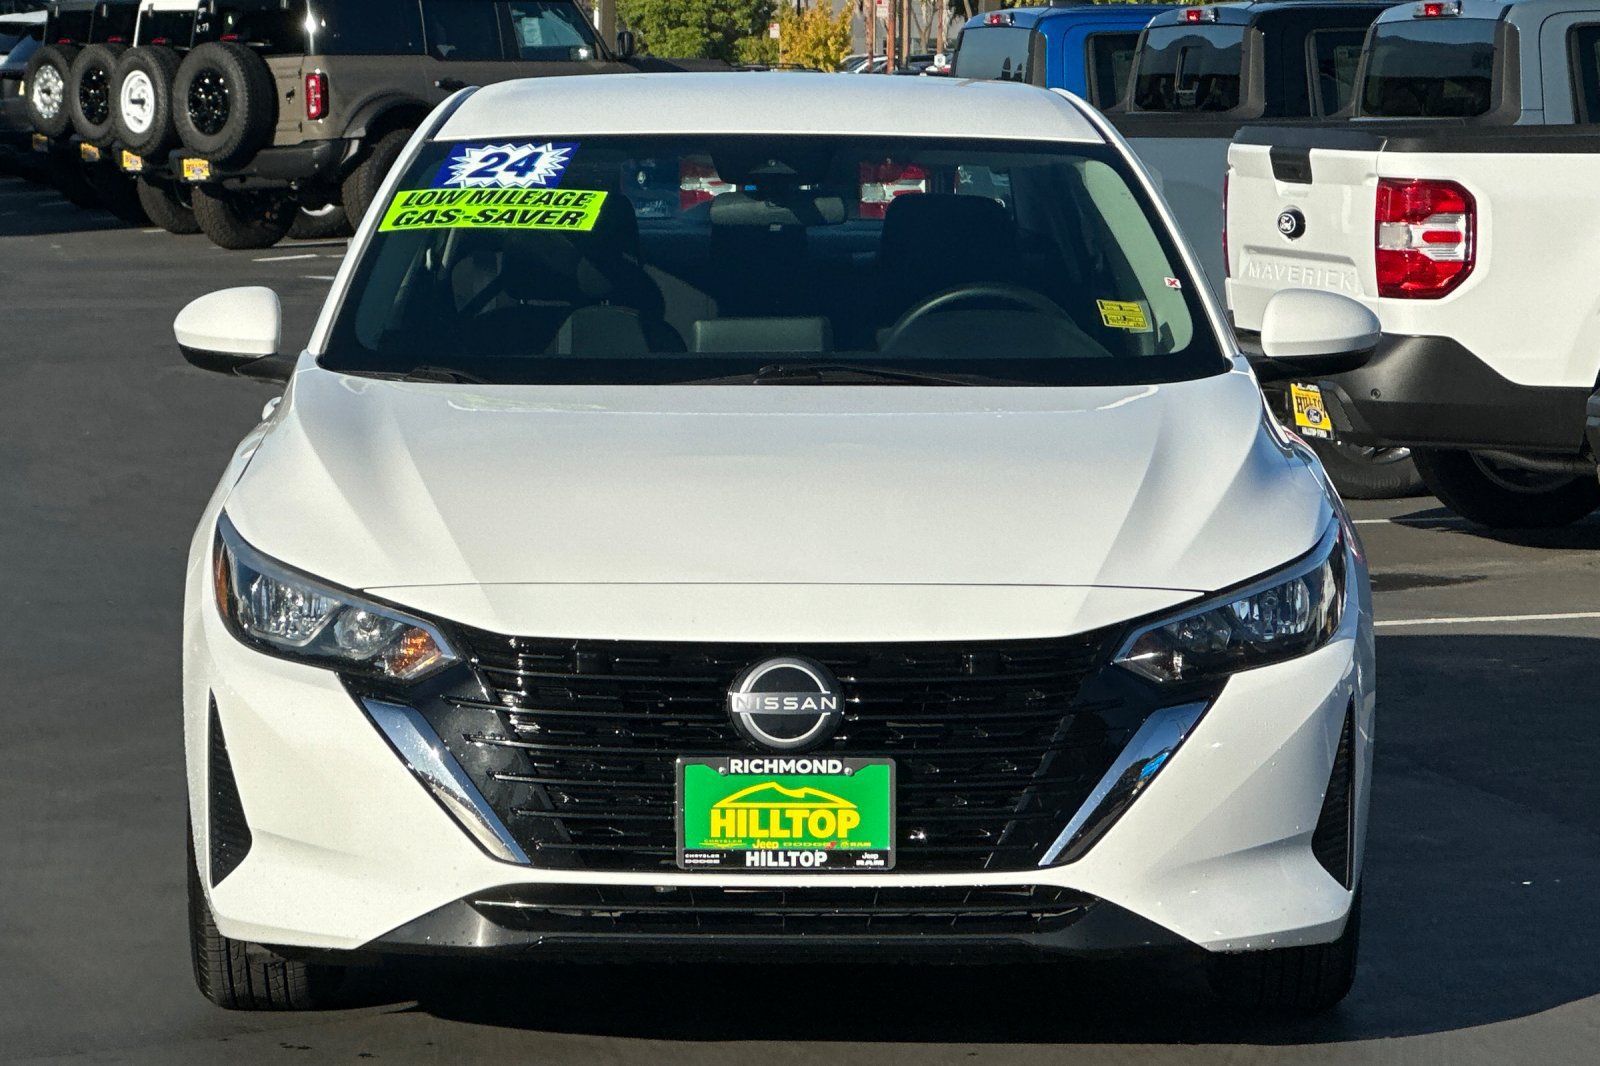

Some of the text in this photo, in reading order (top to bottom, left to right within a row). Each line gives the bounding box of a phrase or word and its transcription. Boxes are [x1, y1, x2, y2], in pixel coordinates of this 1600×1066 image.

[467, 151, 543, 178] 24
[401, 190, 595, 208] LOW MILEAGE
[392, 208, 588, 226] GAS-SAVER
[736, 697, 837, 710] NISSAN
[730, 759, 843, 774] RICHMOND
[710, 809, 860, 839] HILLTOP
[752, 838, 779, 850] Jeep
[745, 851, 828, 867] HILLTOP
[861, 852, 879, 860] Jeep
